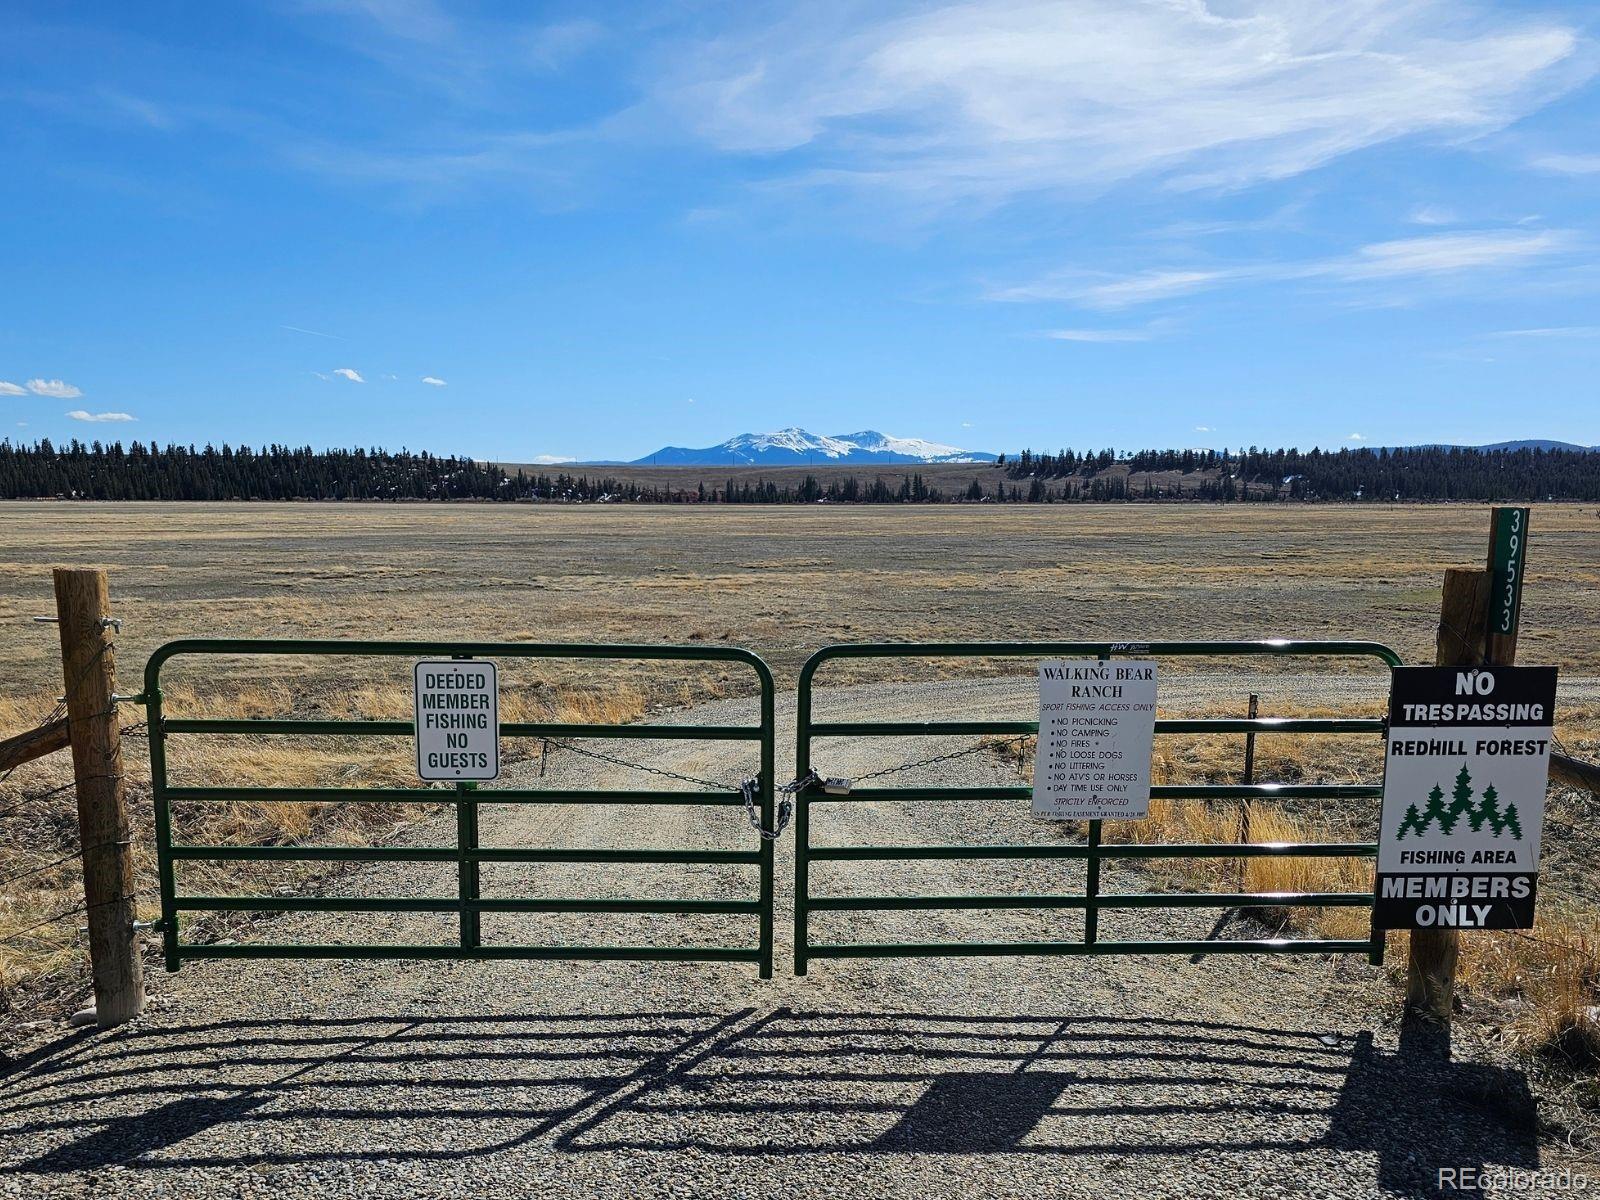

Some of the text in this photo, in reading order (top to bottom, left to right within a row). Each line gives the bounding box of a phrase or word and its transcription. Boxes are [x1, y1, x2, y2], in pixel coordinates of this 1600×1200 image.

[1502, 510, 1520, 631] 39533
[426, 674, 485, 689] DEEDED
[1044, 668, 1153, 680] WALKING BEAR
[1455, 672, 1495, 695] NO
[1072, 686, 1122, 697] RANCH
[423, 694, 489, 709] MEMBER
[1066, 703, 1095, 711] FISHING
[1403, 704, 1543, 721] TRESPASSING
[426, 714, 487, 729] FISHING
[447, 733, 468, 748] NO
[1392, 740, 1548, 756] REDHILL FOREST
[428, 753, 487, 768] GUESTS
[1401, 851, 1516, 864] FISHING AREA
[1382, 877, 1530, 898] MEMBERS
[1416, 904, 1492, 926] ONLY
